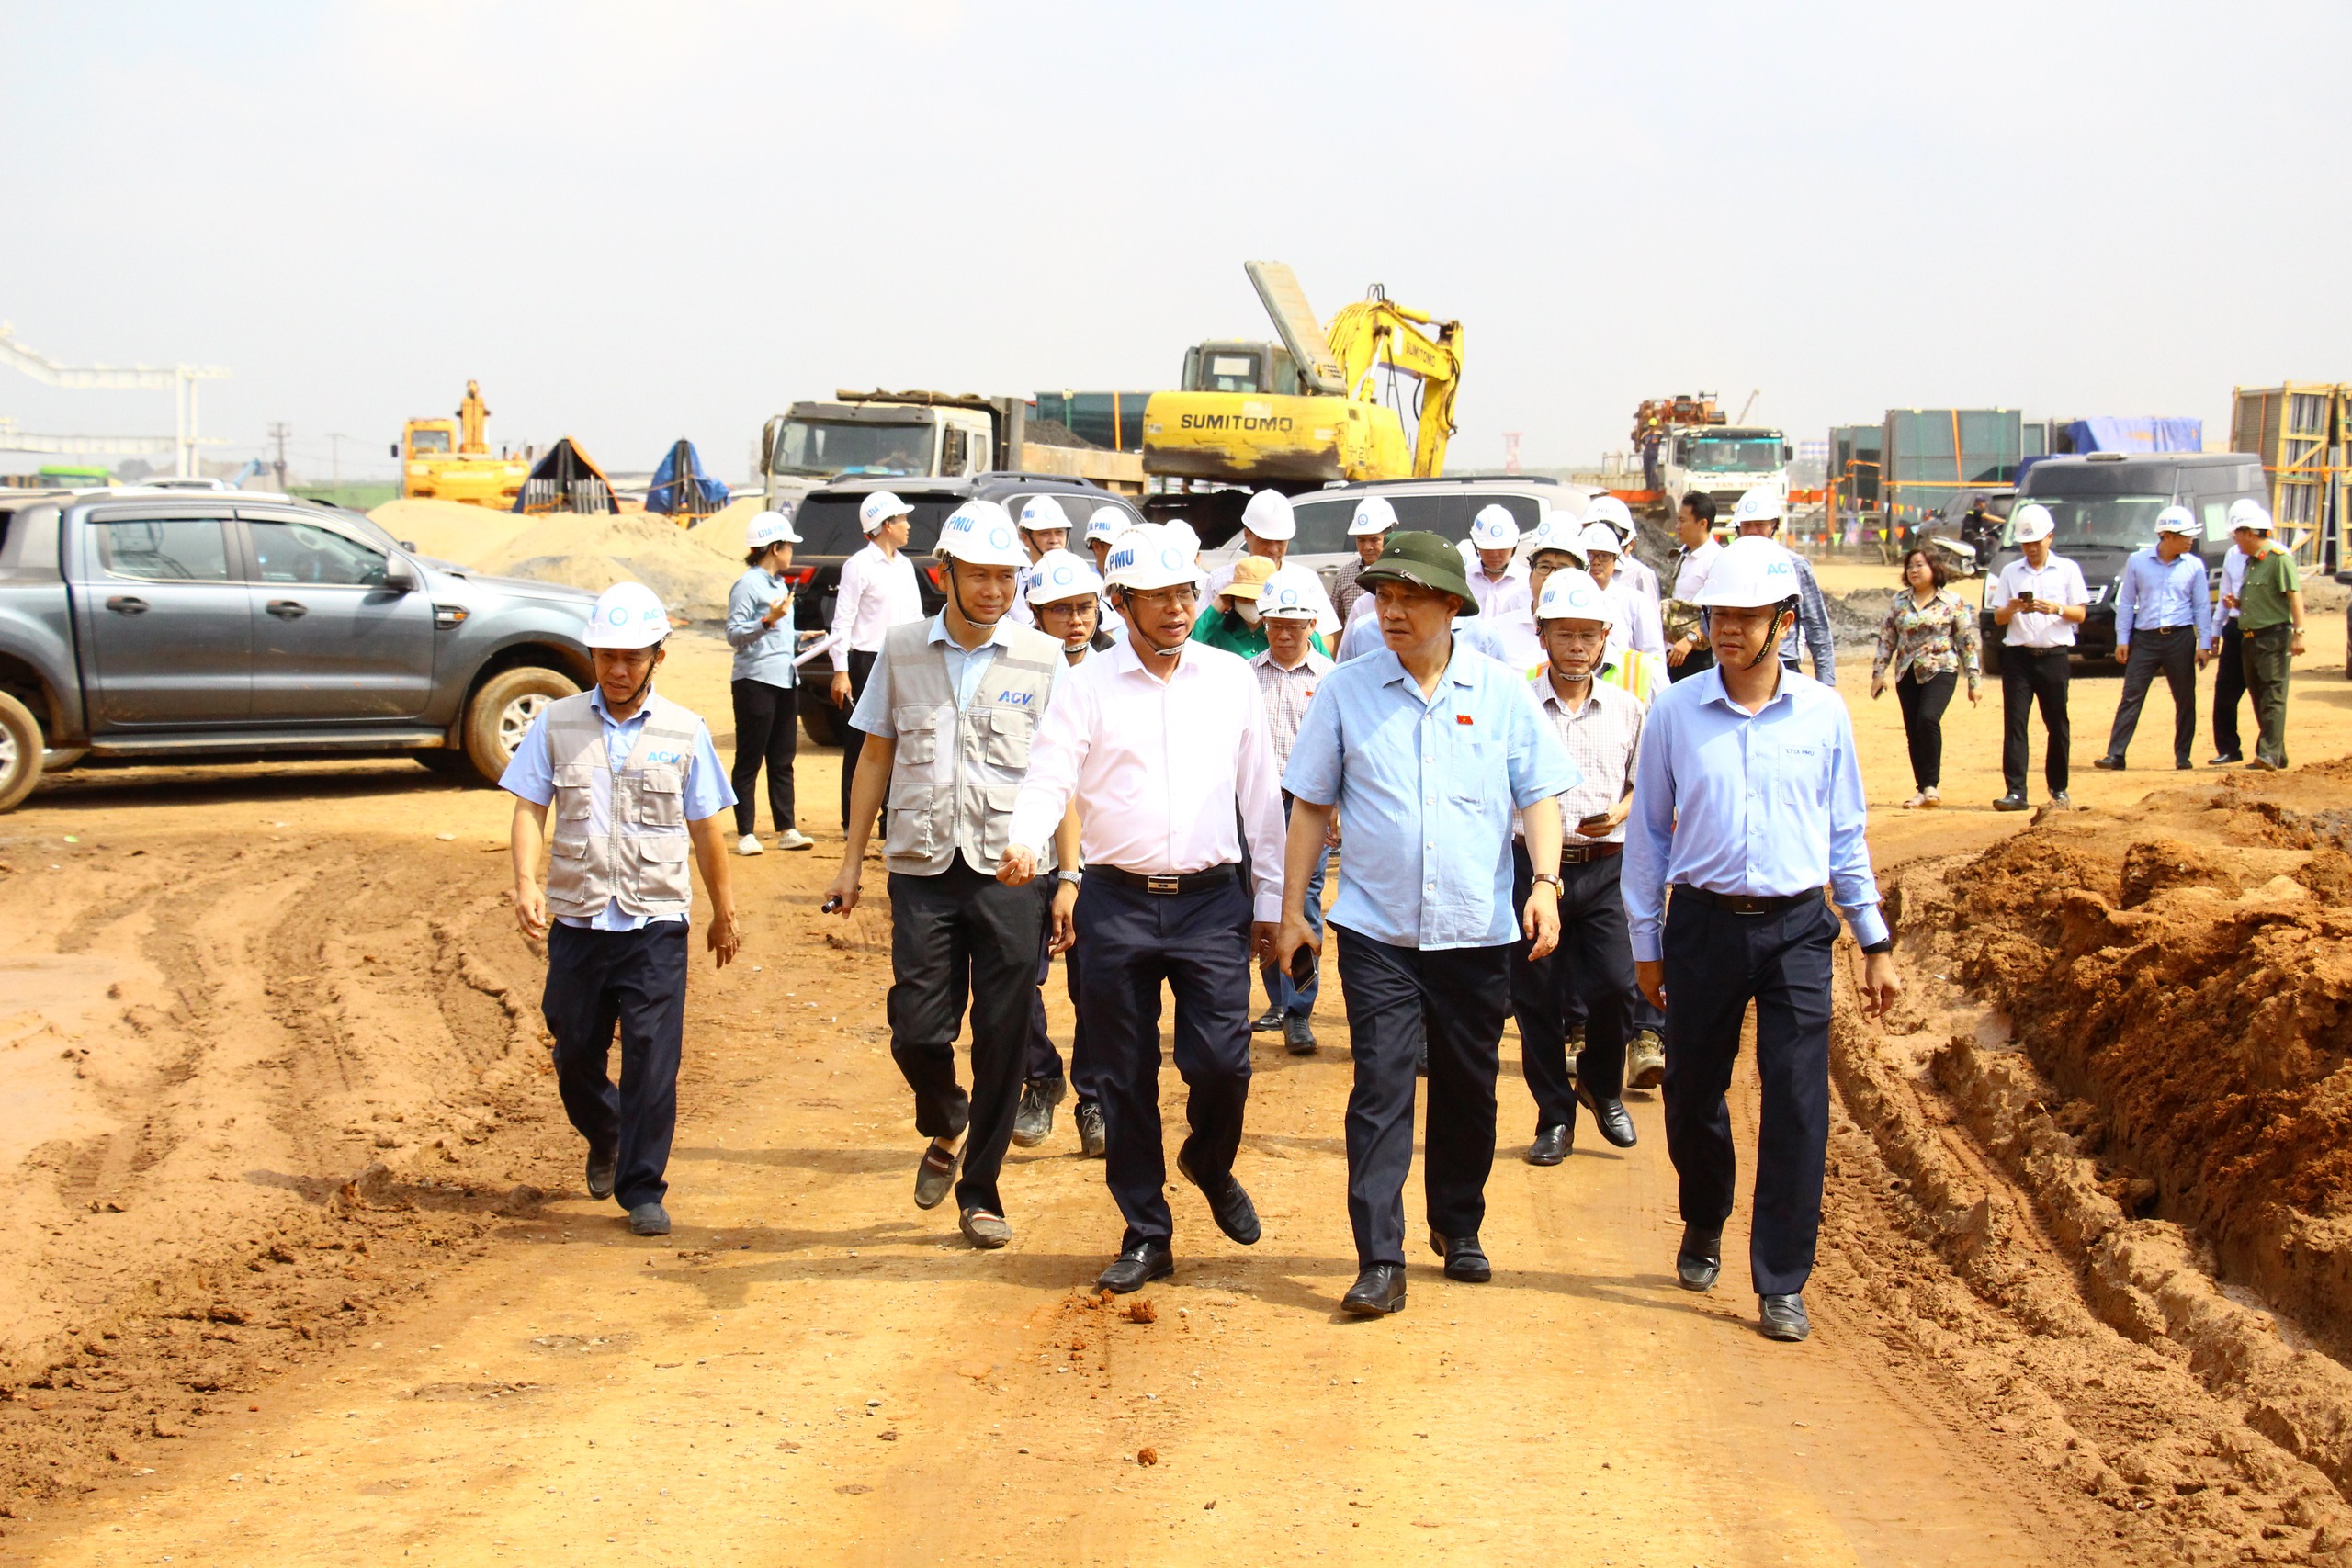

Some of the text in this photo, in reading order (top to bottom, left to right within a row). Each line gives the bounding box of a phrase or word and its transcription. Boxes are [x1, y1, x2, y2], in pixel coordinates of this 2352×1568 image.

[1181, 414, 1294, 432] SUMITOMO
[947, 516, 975, 532] PMU
[1094, 522, 1111, 531] PMU
[1109, 548, 1134, 571] PMU
[998, 690, 1034, 705] ACV
[646, 750, 682, 764] ACV
